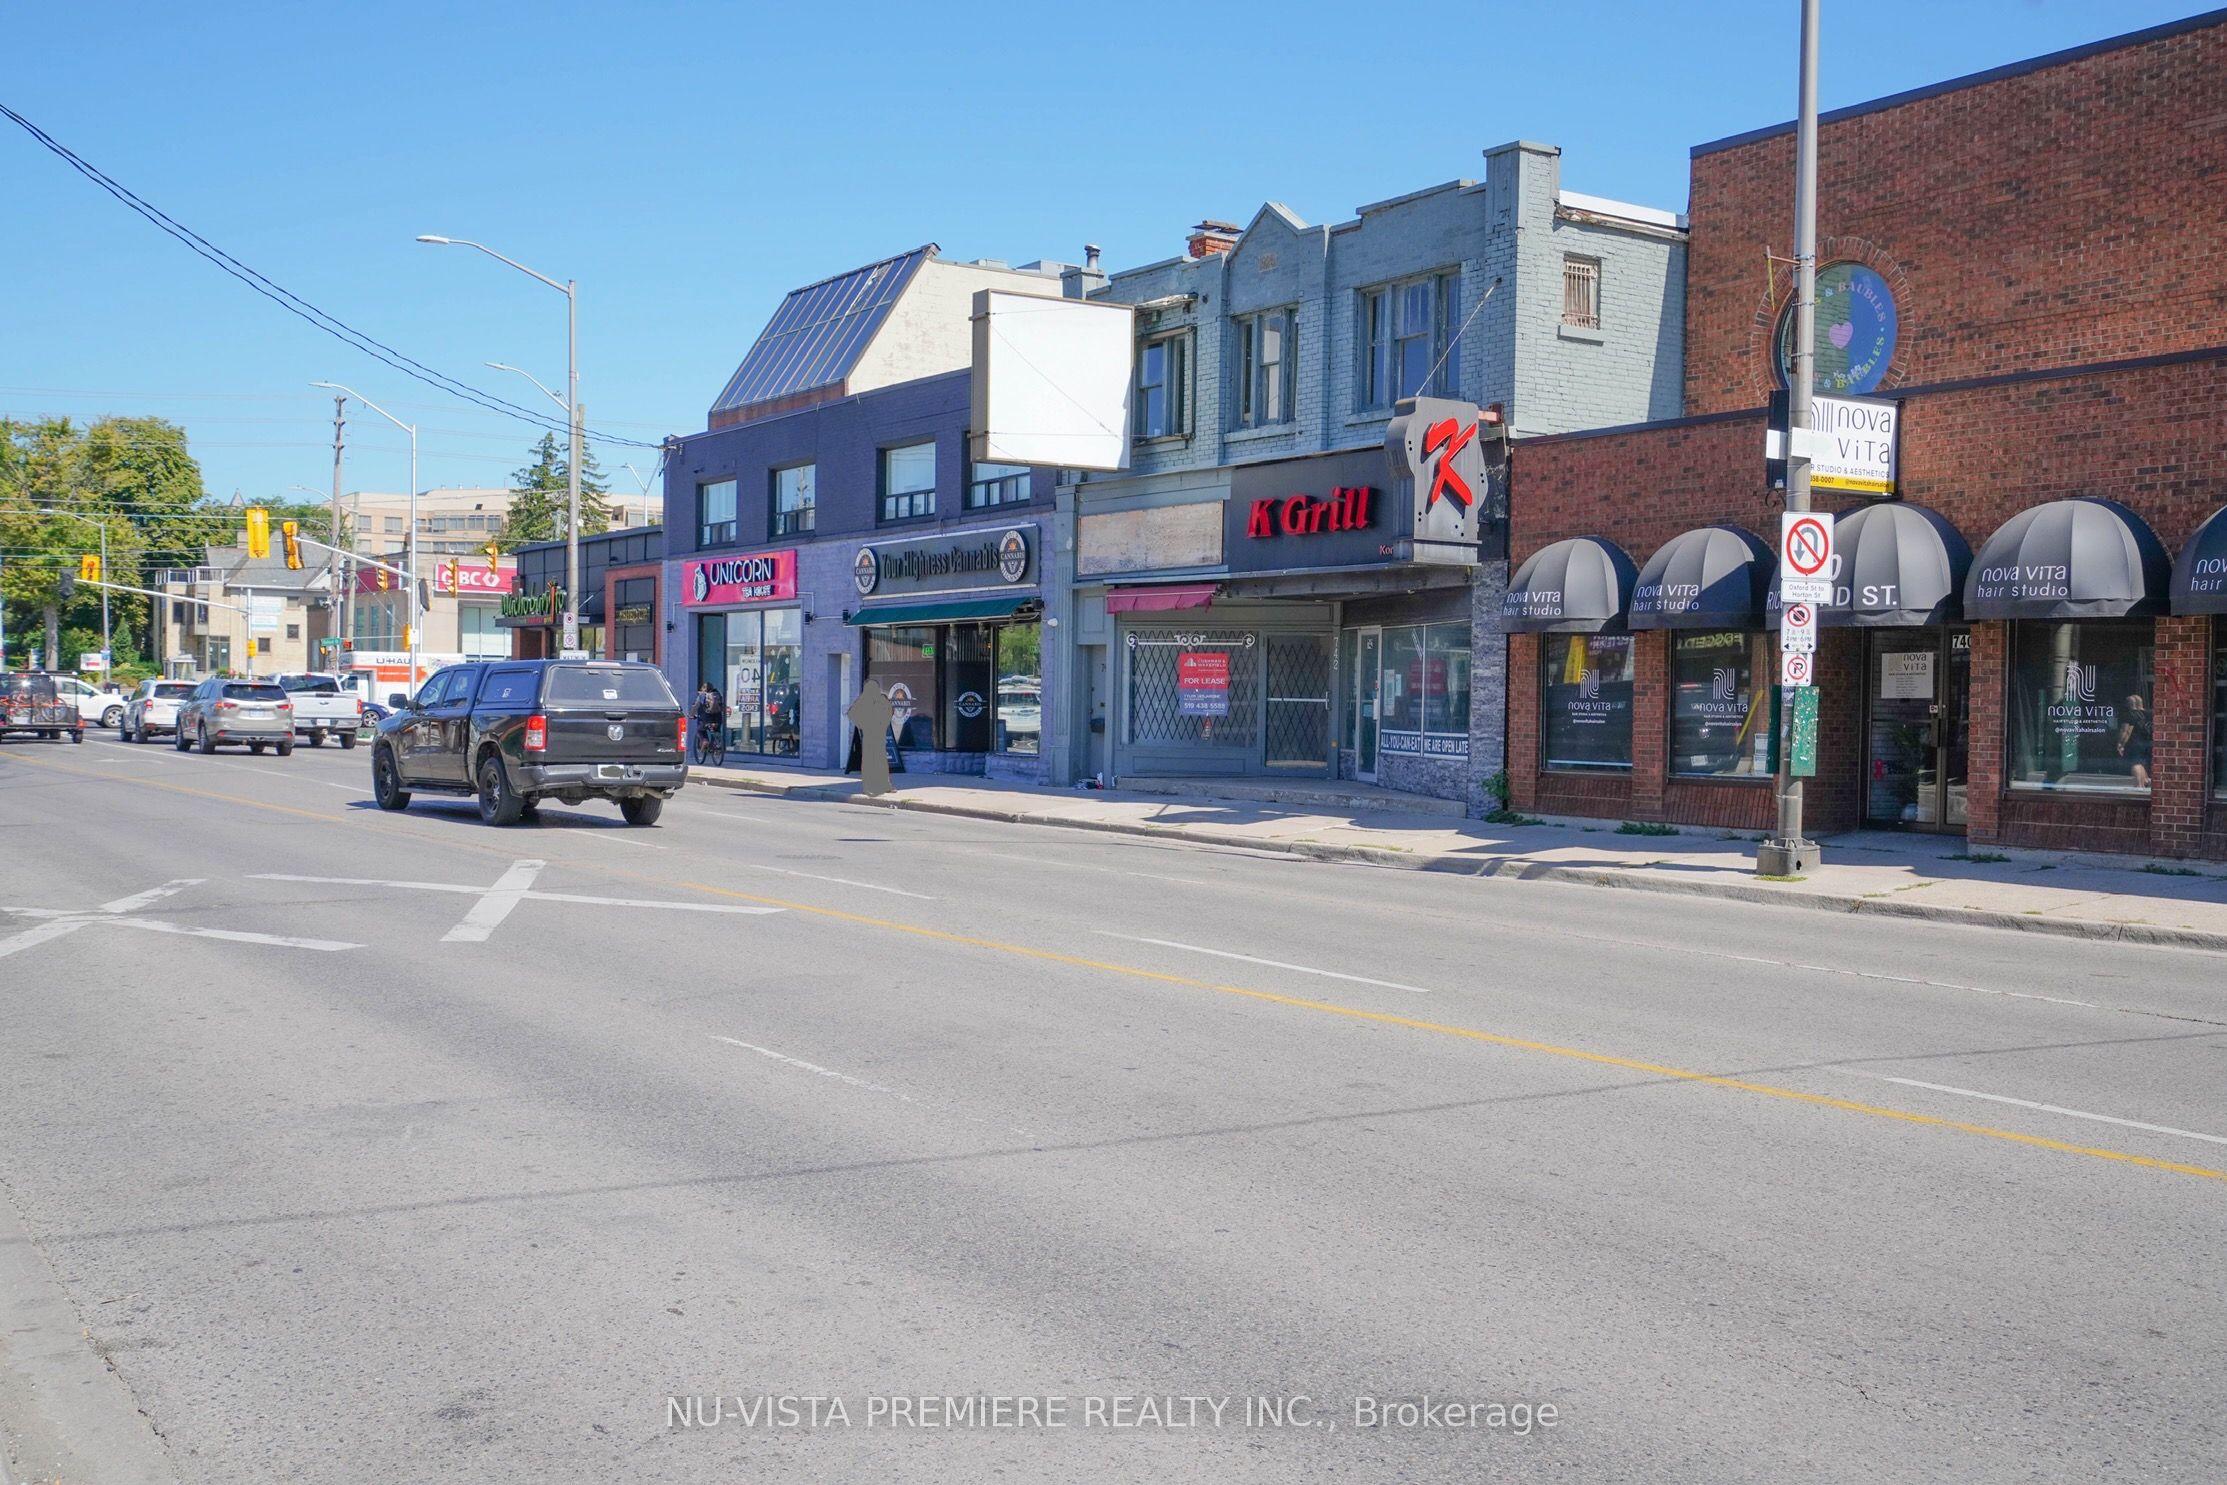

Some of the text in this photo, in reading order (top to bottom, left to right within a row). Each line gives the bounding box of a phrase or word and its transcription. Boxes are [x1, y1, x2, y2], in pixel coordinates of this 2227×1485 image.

[1838, 406, 1891, 433] nova
[1426, 418, 1477, 506] K
[1817, 464, 1842, 474] STUDIO
[1850, 468, 1890, 479] AESTHETICS
[1247, 486, 1371, 539] K Grill
[882, 543, 1000, 581] Your Highness Cannabis
[441, 571, 483, 586] CBC
[710, 558, 771, 586] UNICORN
[1982, 566, 2020, 582] nova
[1978, 582, 2068, 598] hair studio
[2190, 577, 2222, 591] hair
[1507, 592, 1528, 603] nova
[1637, 585, 1663, 598] nova
[1862, 585, 1898, 606] ST.
[1503, 604, 1562, 616] hair studio
[1633, 598, 1699, 612] hair studio
[1184, 677, 1225, 685] FOR LEASE
[1568, 701, 1591, 711] nova
[1700, 702, 1725, 712] nova
[2047, 706, 2082, 717] nova
[1432, 739, 1441, 751] ARE
[1442, 740, 1455, 753] OPEN
[1456, 741, 1468, 753] LATE
